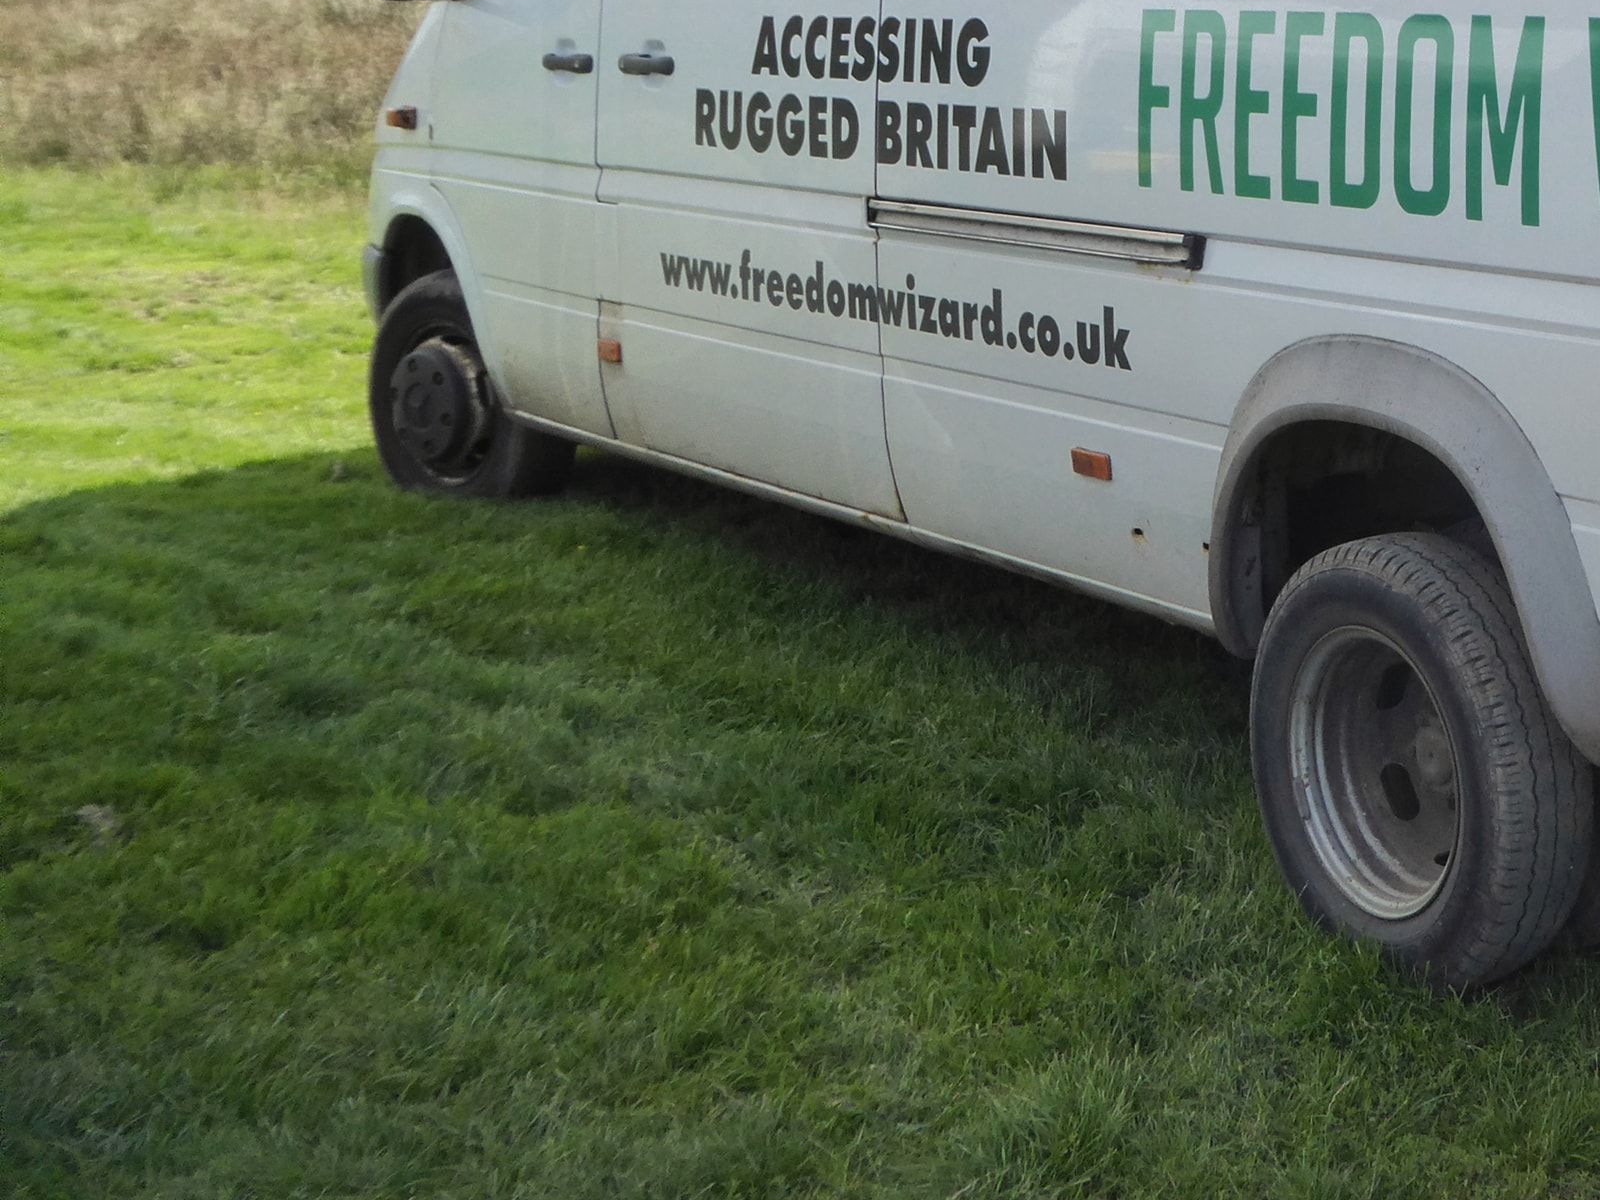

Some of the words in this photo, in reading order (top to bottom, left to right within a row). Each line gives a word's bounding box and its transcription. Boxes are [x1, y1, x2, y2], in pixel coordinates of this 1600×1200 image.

[751, 15, 991, 87] ACCESSING
[695, 88, 860, 161] RUGGED
[876, 100, 1068, 182] BRITAIN
[1137, 8, 1545, 228] FREEDOM
[659, 249, 1133, 372] www.freedomwizard.co.uk
